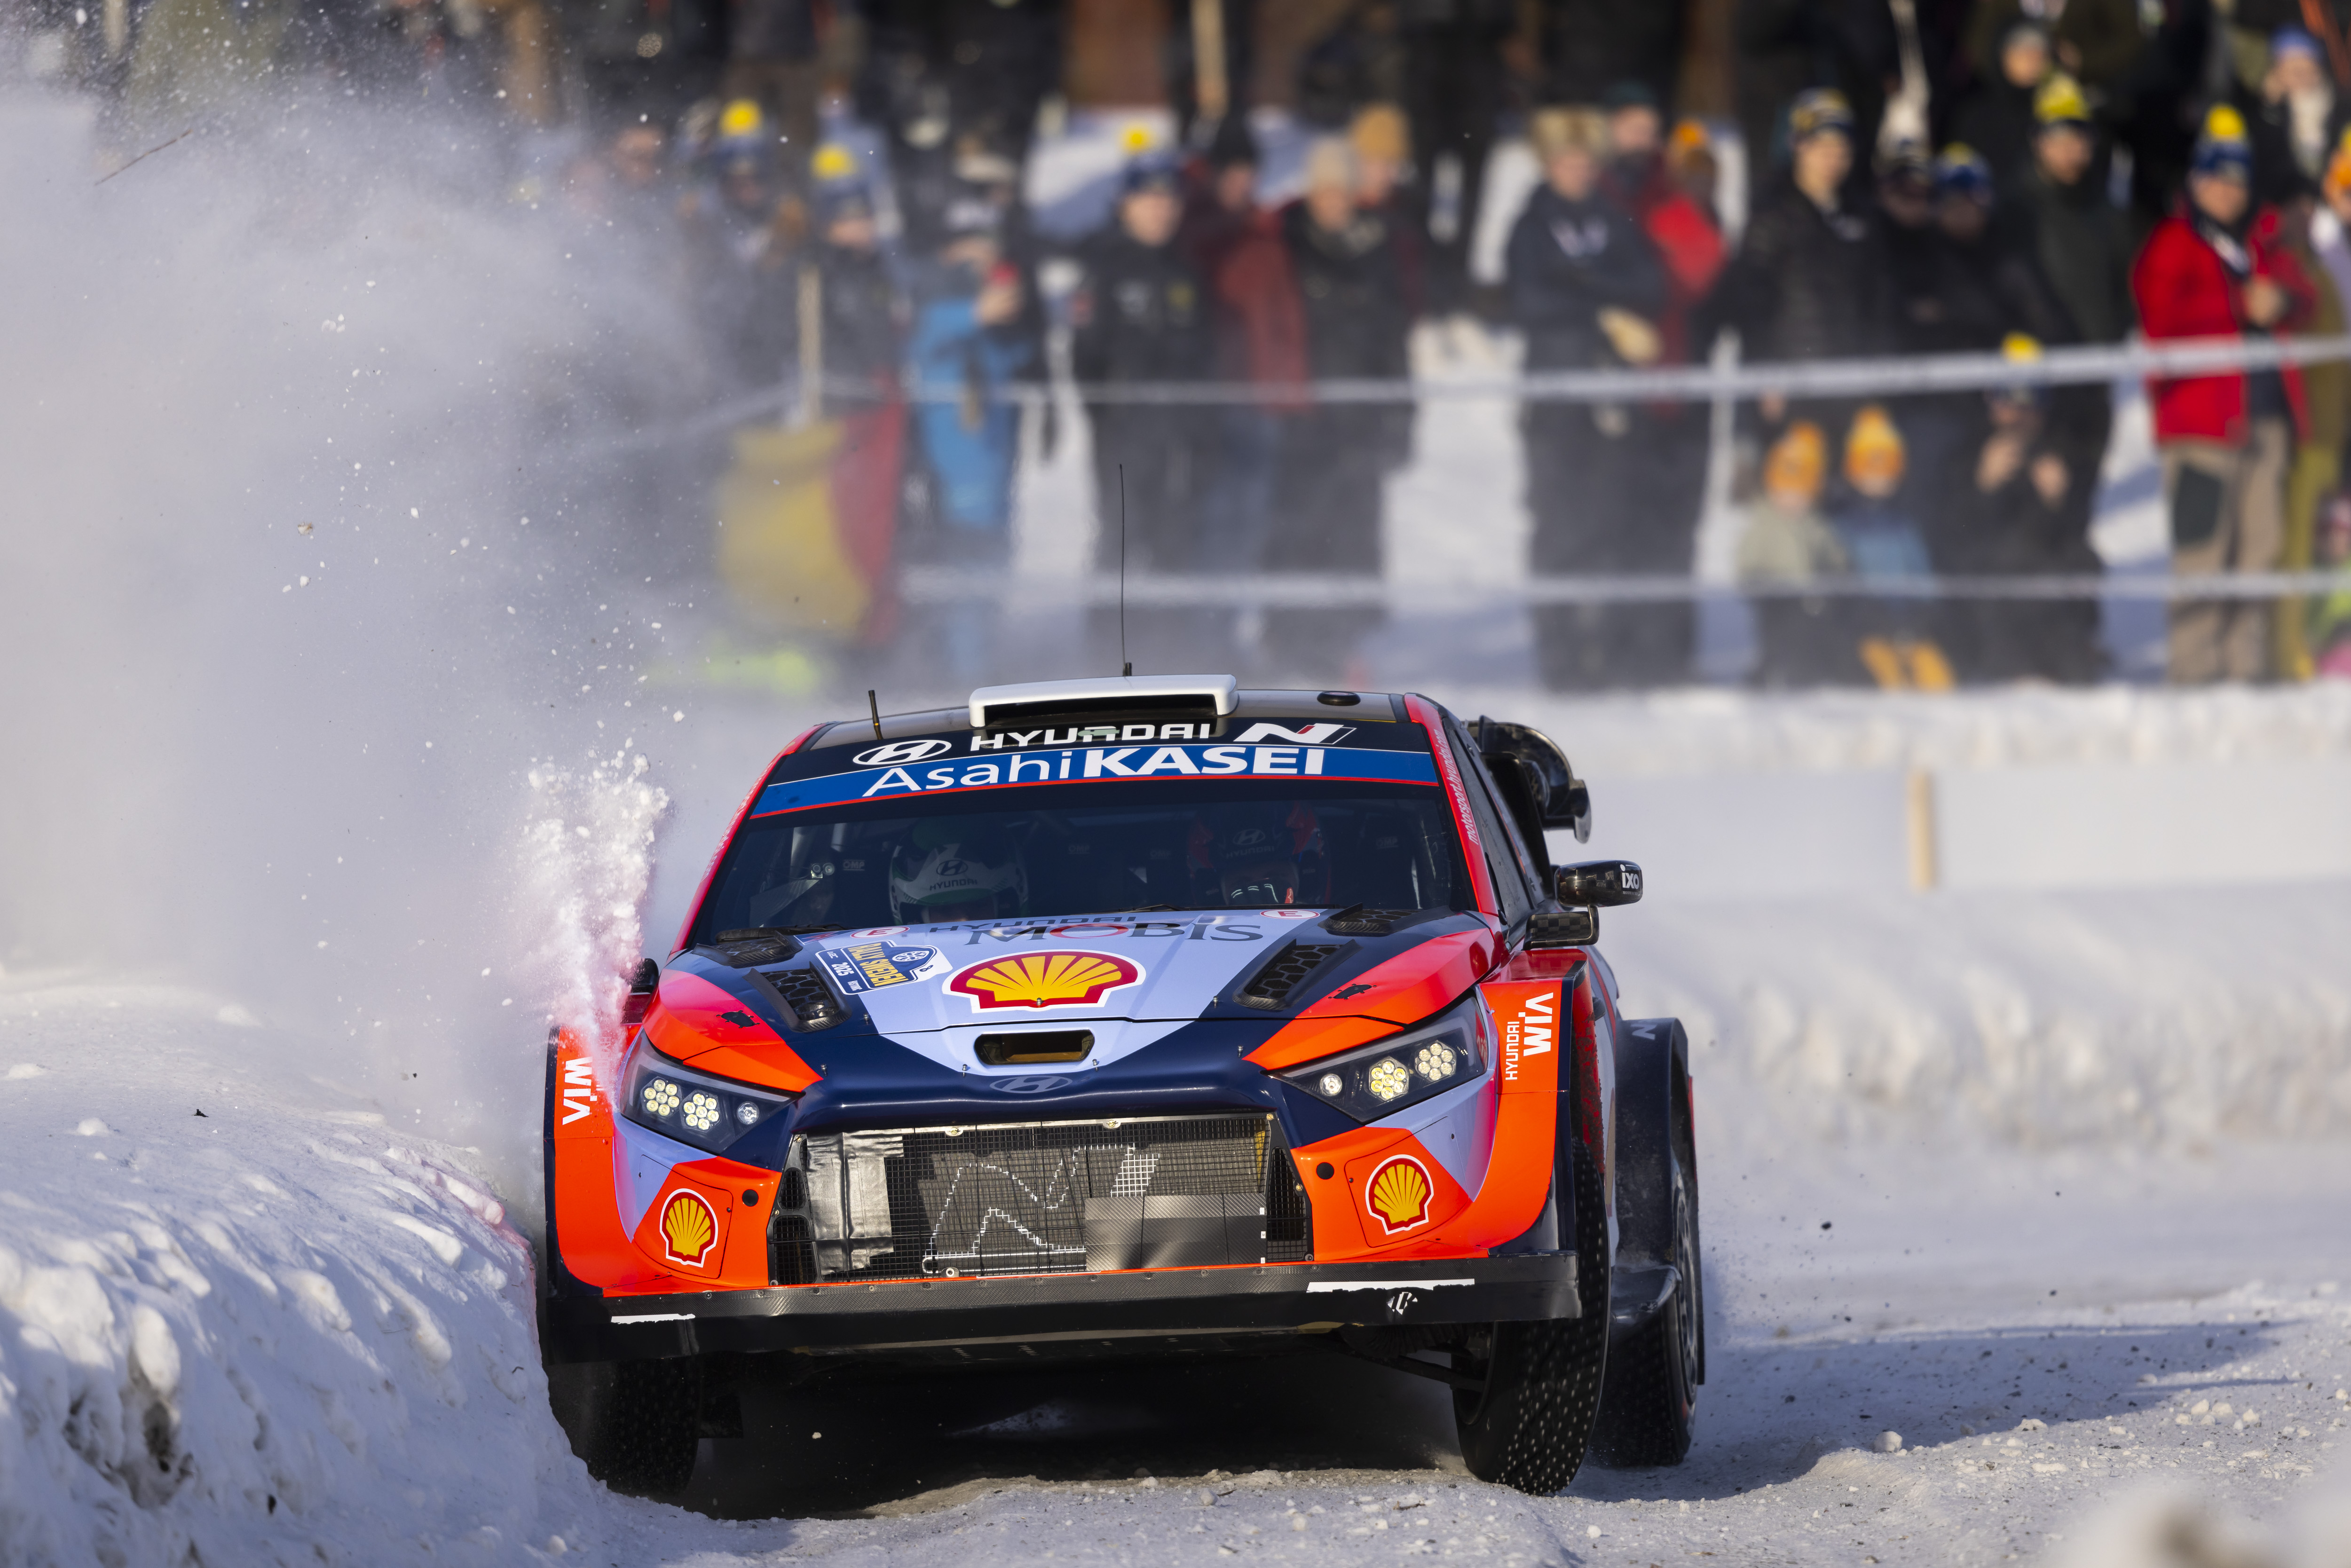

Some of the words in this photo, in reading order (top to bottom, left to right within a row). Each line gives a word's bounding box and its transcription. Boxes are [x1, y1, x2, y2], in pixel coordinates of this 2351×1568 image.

[970, 723, 1210, 751] HYUNDAI
[1434, 729, 1478, 845] motorsport.hyundai.com
[1226, 845, 1275, 858] HYUNDAI
[930, 879, 978, 890] HYUNDAI
[929, 916, 1136, 933] HYUNDAI
[965, 922, 1263, 946] MOBIS
[847, 942, 886, 961] RALLY
[831, 962, 855, 977] 2025
[859, 958, 909, 987] SWEDEN
[1505, 1021, 1520, 1080] HYUNDAI
